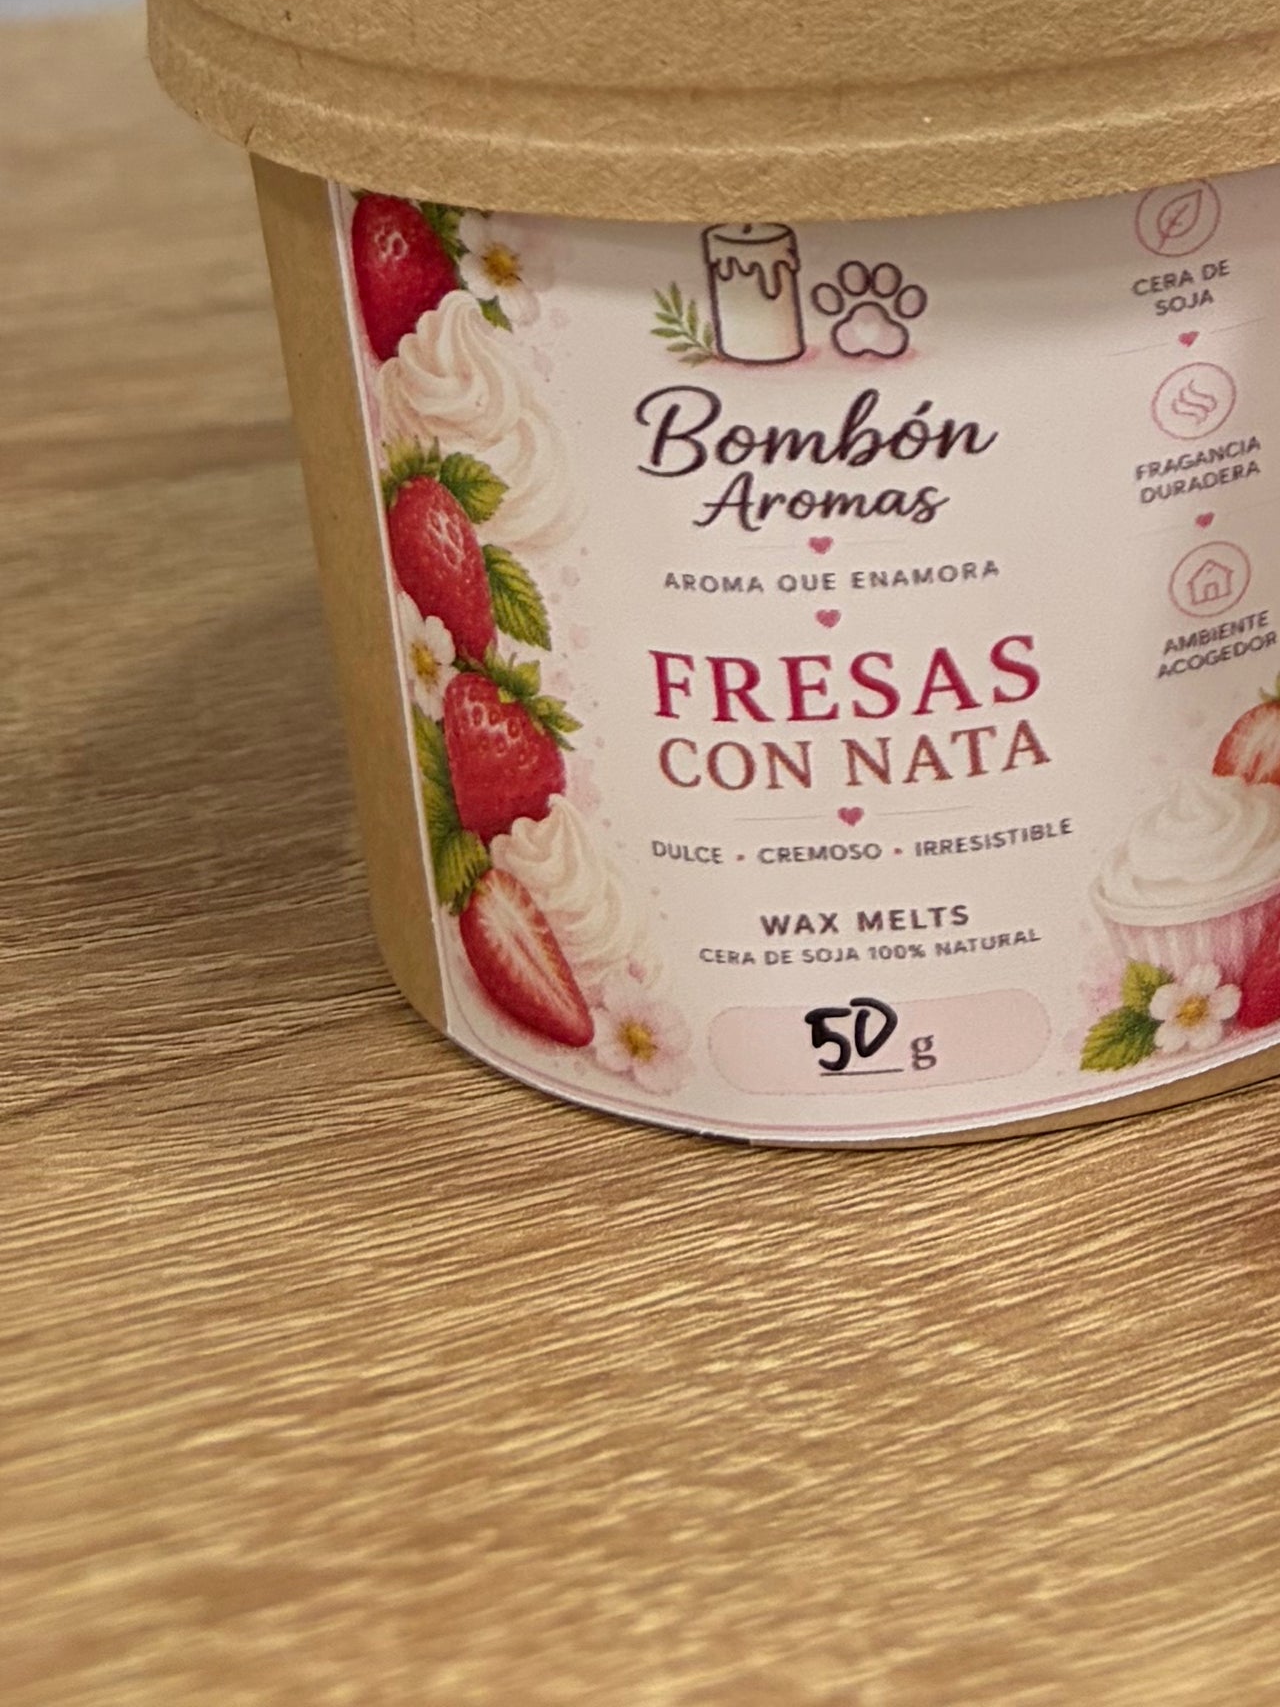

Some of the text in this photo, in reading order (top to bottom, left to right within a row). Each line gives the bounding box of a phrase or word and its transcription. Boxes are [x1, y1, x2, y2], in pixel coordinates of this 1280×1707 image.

[1131, 258, 1231, 297] CERA DE
[1155, 289, 1215, 317] SOJA
[634, 385, 999, 478] Bombón
[1135, 436, 1262, 481] FRAGANCIA
[692, 470, 950, 532] Aromas
[1140, 460, 1261, 504] DURADERA
[664, 560, 1000, 594] AROMA QUE ENAMORA
[1156, 630, 1278, 679] ACOGEDOR
[1163, 610, 1270, 656] AMBIENTE
[648, 634, 1041, 722] FRESAS
[658, 719, 1052, 791] CON NATA
[651, 817, 1074, 864] DULCE CREMOSO IRRESISTIBLE
[760, 905, 969, 937] WAX MELTS
[699, 928, 1042, 966] CERA DE SOJA 100% NATURAL
[910, 1034, 937, 1072] g
